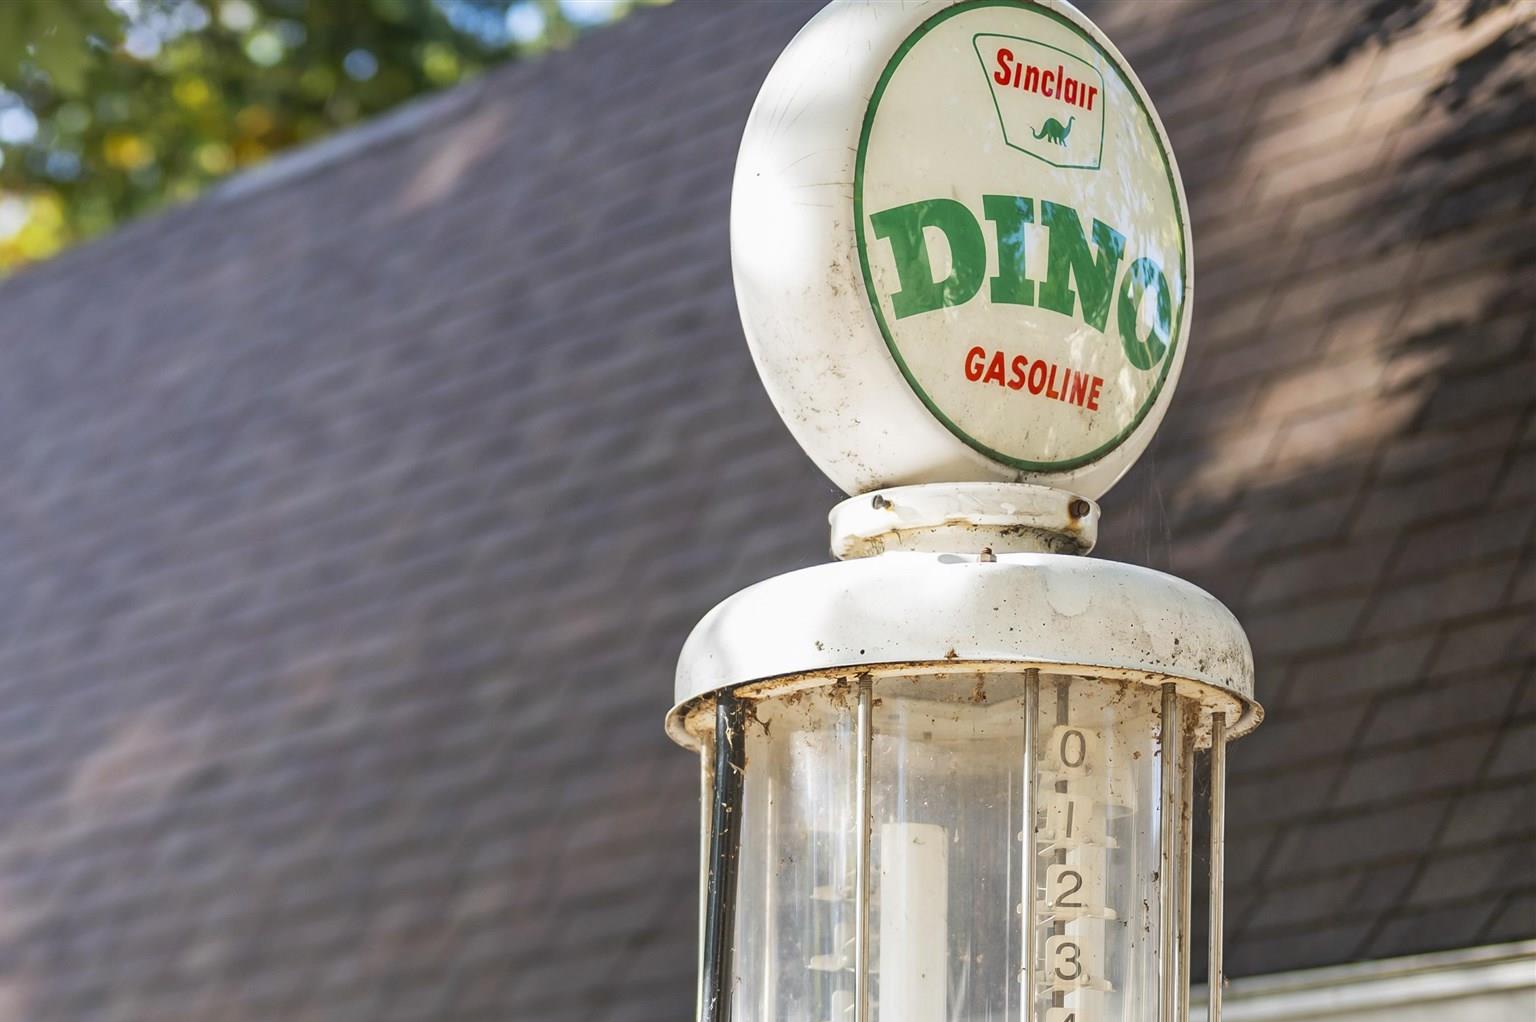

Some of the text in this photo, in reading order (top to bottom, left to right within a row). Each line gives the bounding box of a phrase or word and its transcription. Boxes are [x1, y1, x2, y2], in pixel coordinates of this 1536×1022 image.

[994, 48, 1098, 111] Sinclair
[869, 194, 1172, 371] DINO
[965, 346, 1104, 411] GASOLINE
[1060, 729, 1086, 768] 0
[1066, 801, 1074, 838] 1
[1055, 870, 1083, 908] 2
[1054, 942, 1082, 980] 3
